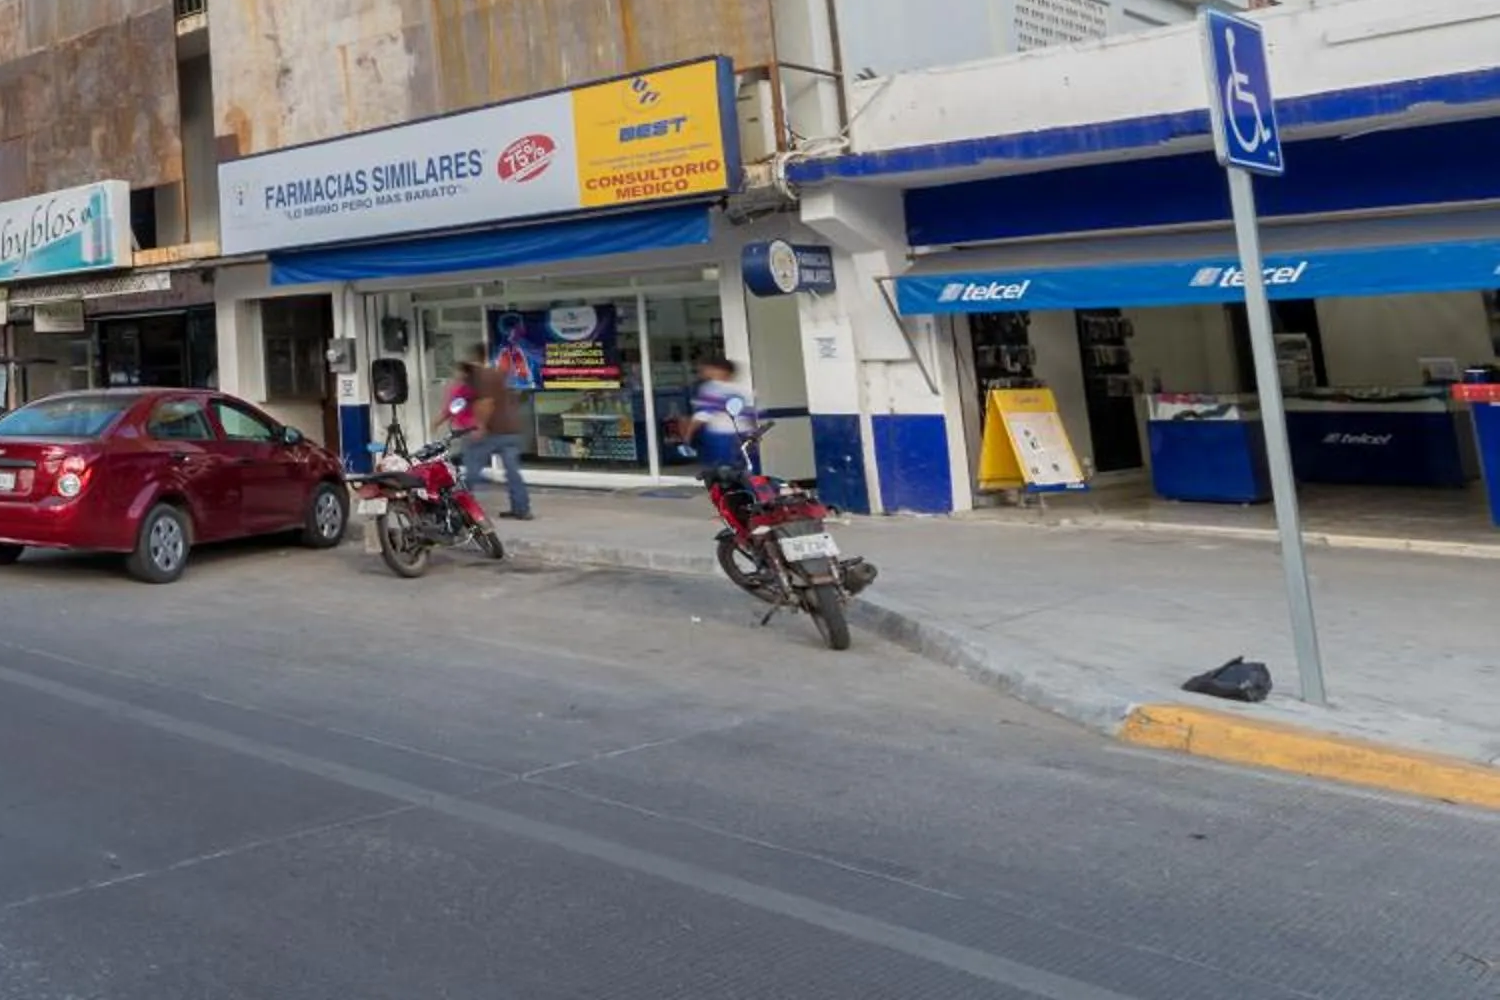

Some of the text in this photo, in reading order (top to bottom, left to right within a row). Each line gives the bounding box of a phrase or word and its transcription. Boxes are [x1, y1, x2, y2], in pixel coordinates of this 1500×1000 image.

[619, 116, 688, 142] BEST
[265, 170, 367, 210] FARMACIAS
[372, 149, 482, 193] SIMILARES
[585, 159, 720, 190] CONSULTORIO
[616, 179, 689, 200] MEDICO
[341, 198, 373, 212] PERO
[1, 199, 75, 273] byblos
[962, 279, 1031, 301] telcel
